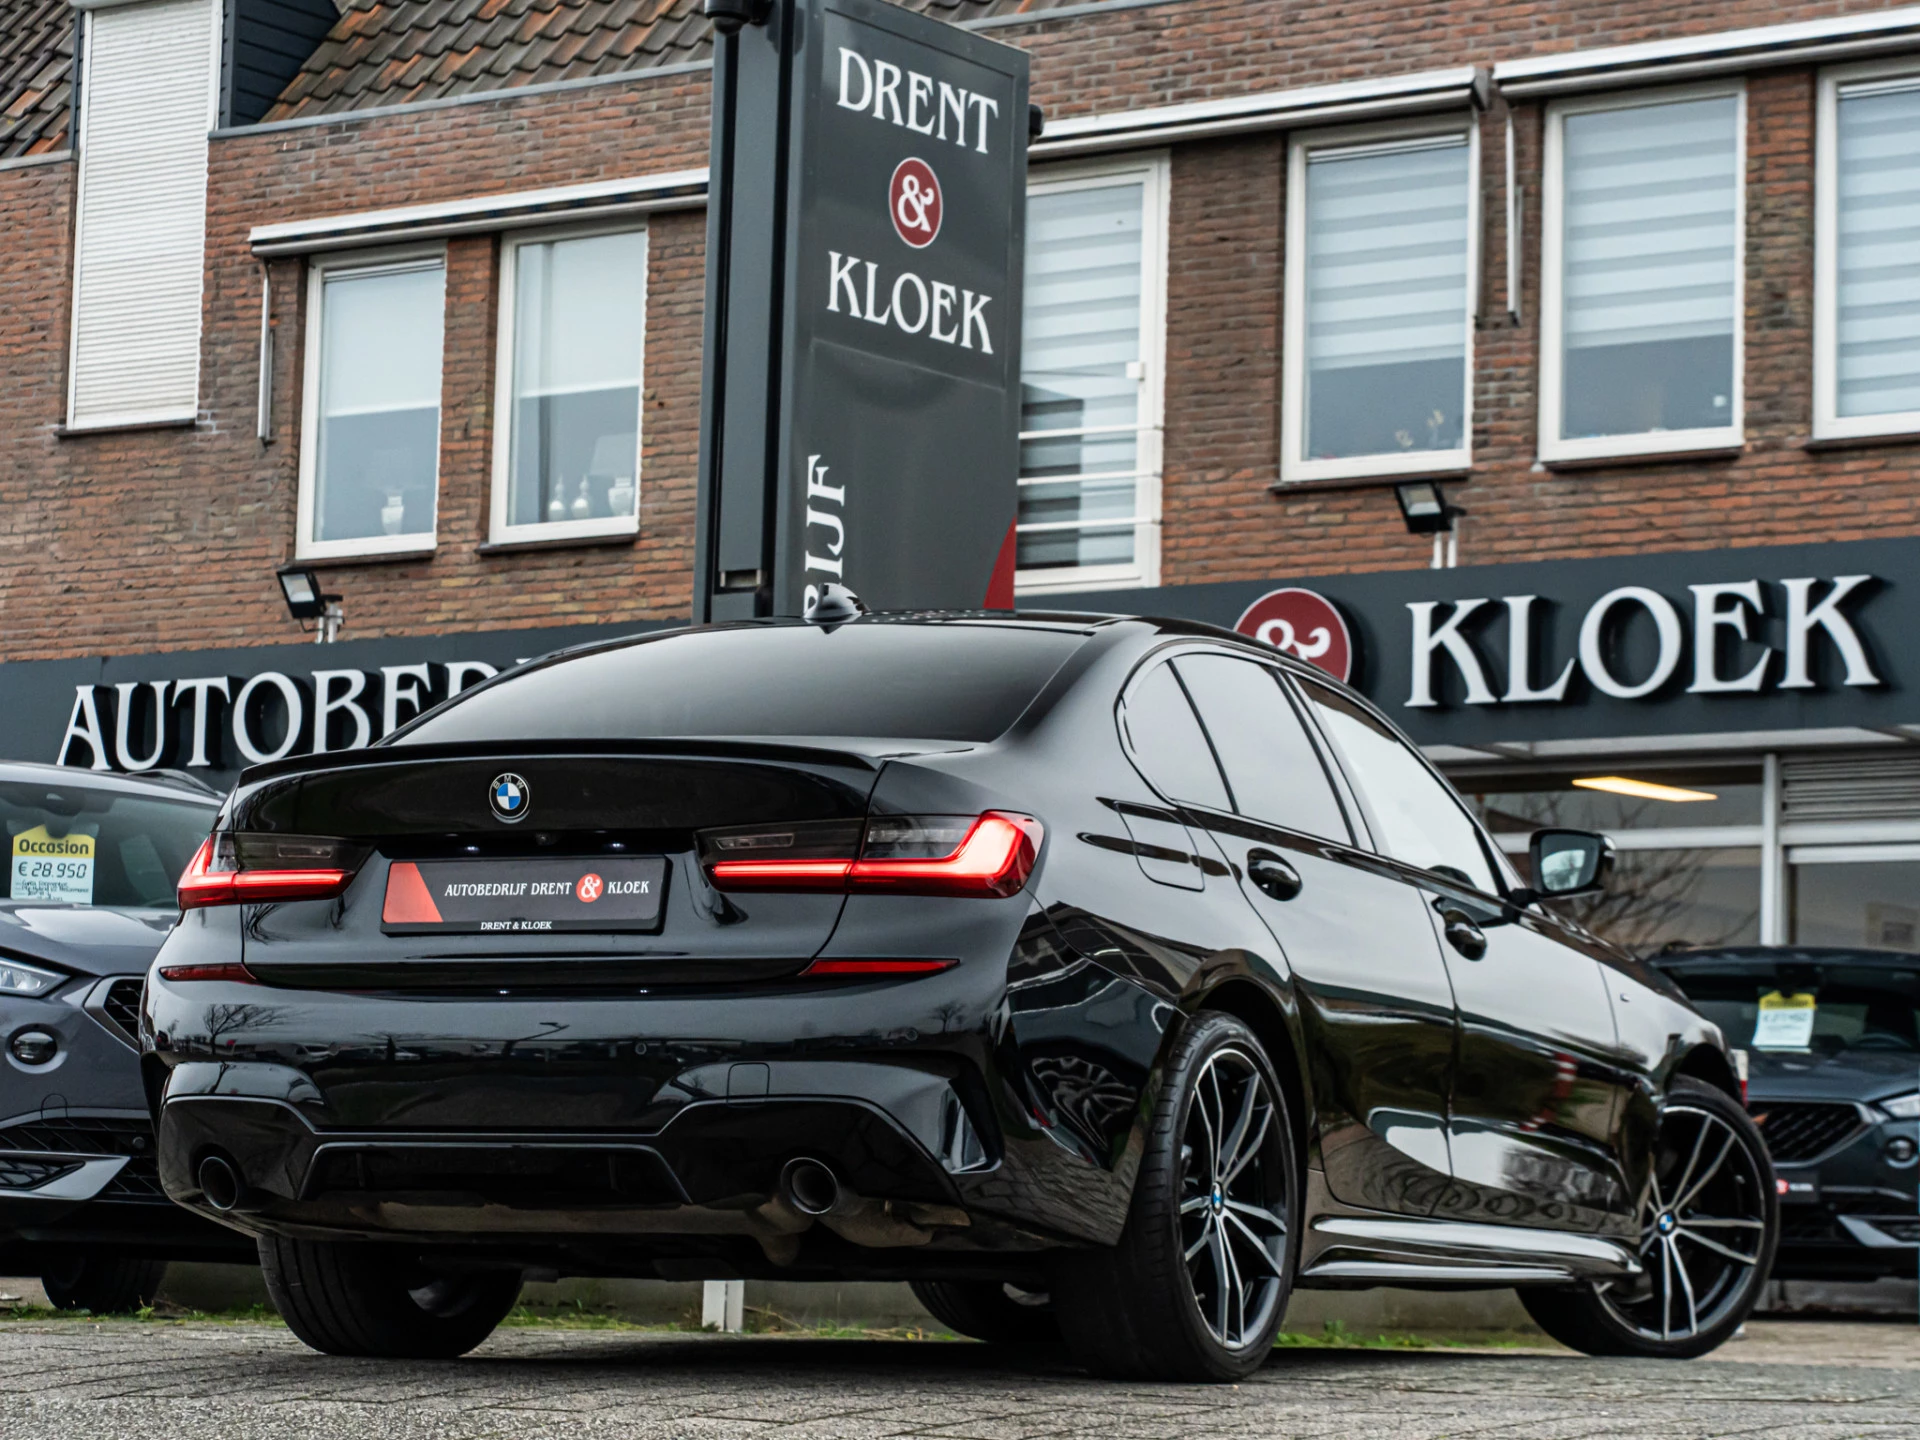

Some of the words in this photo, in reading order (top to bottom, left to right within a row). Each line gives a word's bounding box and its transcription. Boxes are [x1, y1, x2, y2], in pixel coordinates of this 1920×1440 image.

[836, 46, 999, 154] DRENT
[898, 174, 935, 233] &
[826, 250, 994, 355] KLOEK
[1404, 575, 1881, 708] KLOEK
[492, 774, 525, 790] BMW
[18, 838, 90, 855] Occasion
[18, 861, 29, 877] €
[444, 883, 528, 897] AUTOBEDRIJF
[531, 882, 573, 896] DRENT
[580, 876, 601, 899] &
[607, 881, 650, 894] KLOEK
[480, 921, 512, 930] DRENT
[512, 921, 519, 930] &
[521, 921, 552, 930] KLOEK
